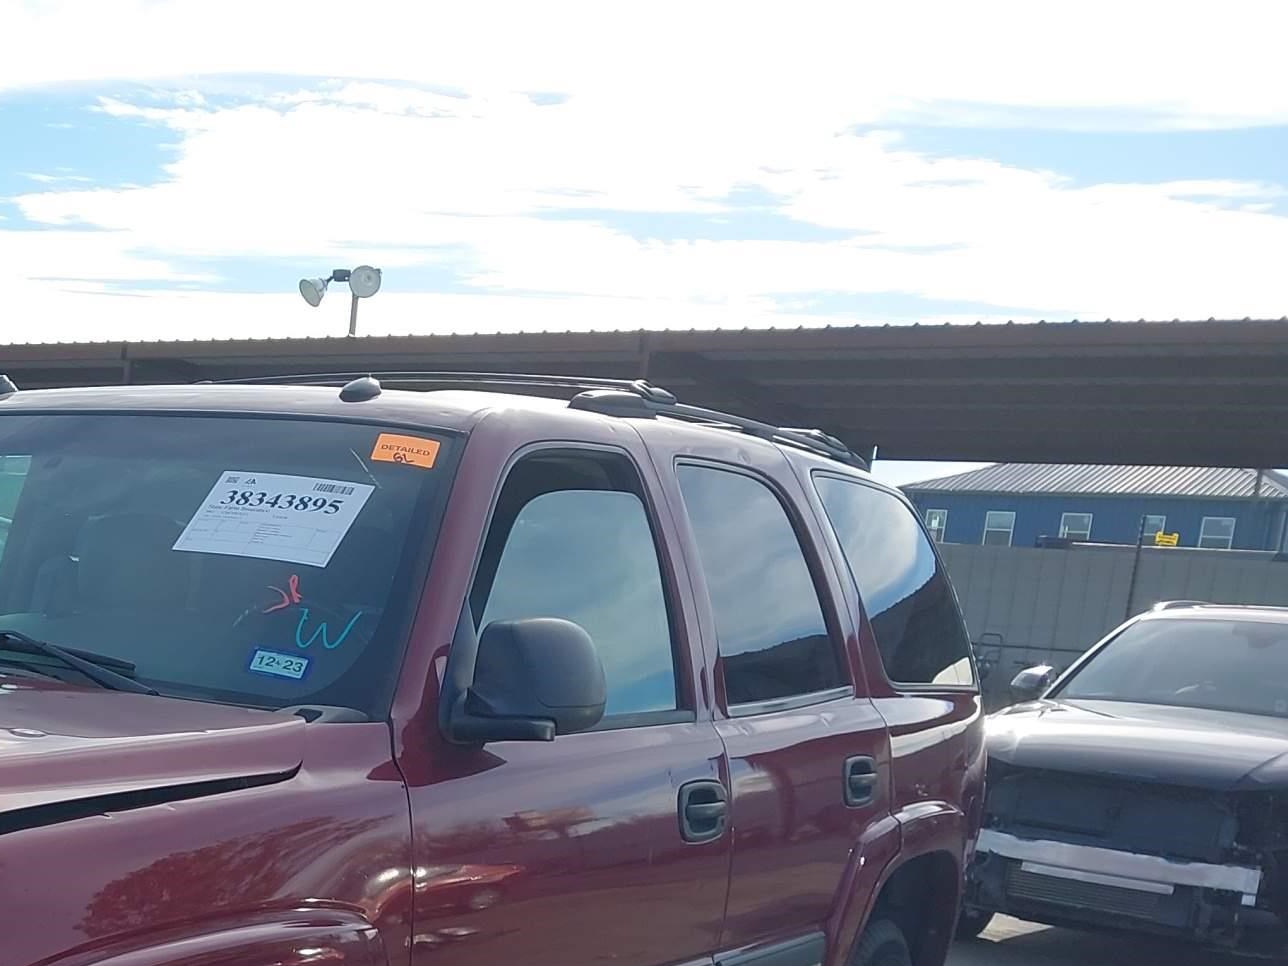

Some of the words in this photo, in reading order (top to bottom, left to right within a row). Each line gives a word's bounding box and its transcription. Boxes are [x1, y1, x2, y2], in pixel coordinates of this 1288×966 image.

[380, 444, 430, 456] DETAILED
[220, 489, 344, 514] 38343895
[257, 656, 276, 668] 12
[282, 659, 304, 673] 23
